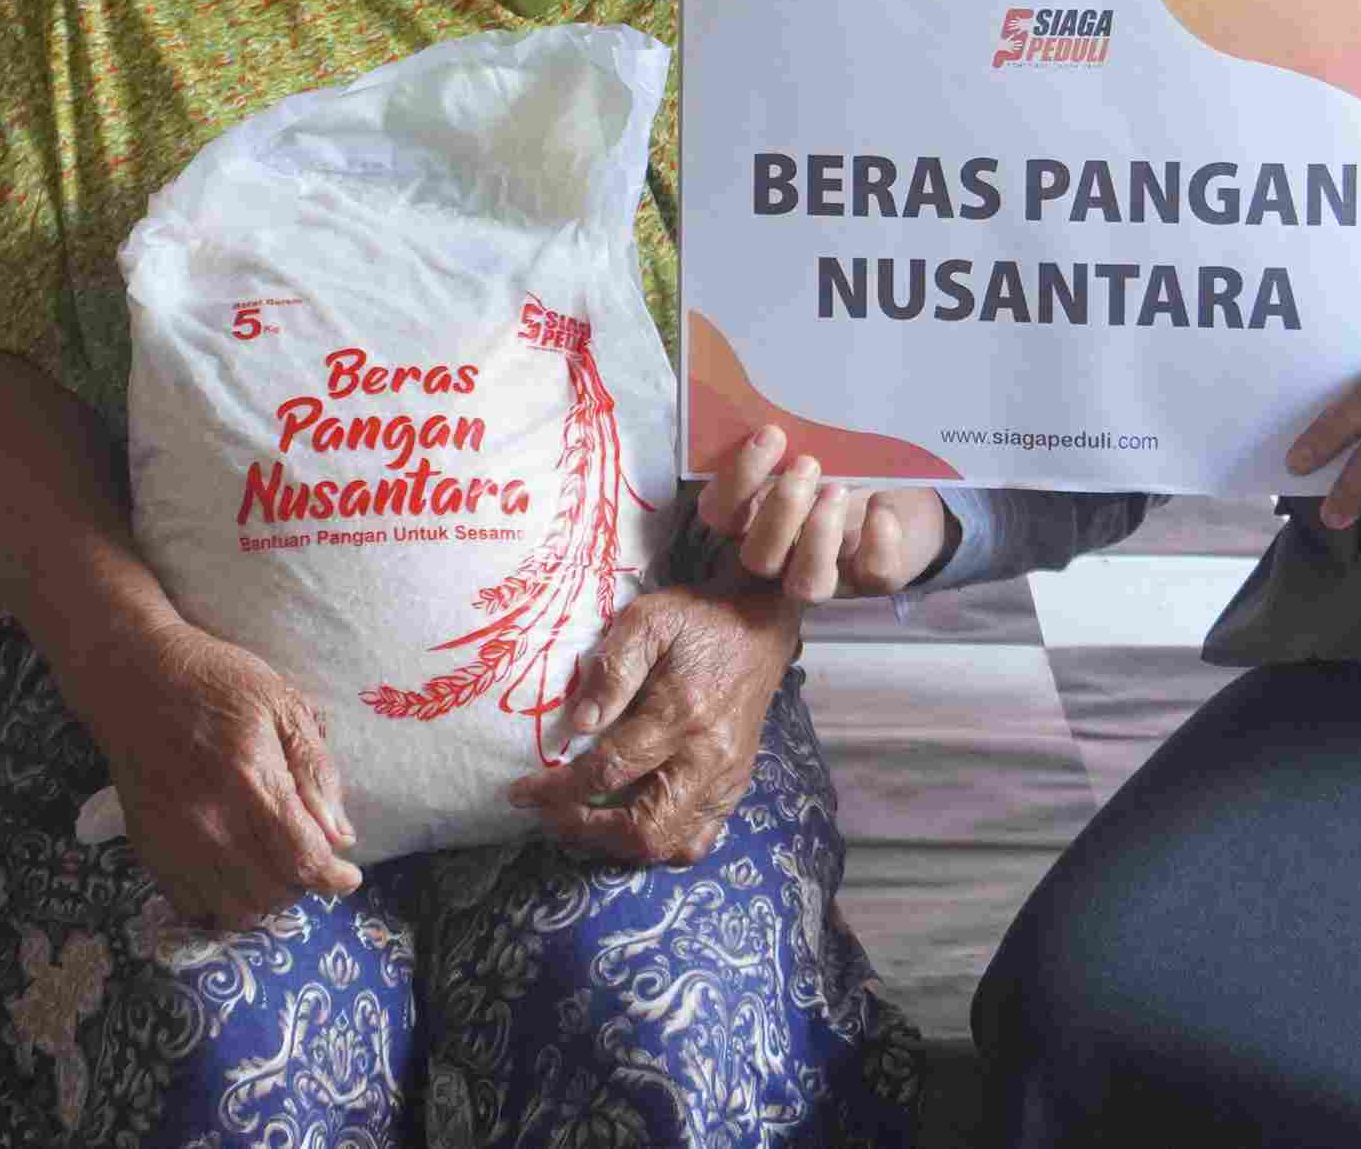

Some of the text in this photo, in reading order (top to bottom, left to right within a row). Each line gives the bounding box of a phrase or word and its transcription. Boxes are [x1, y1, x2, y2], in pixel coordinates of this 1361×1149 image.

[1034, 8, 1114, 37] SIAGA
[1026, 37, 1111, 62] PEDULI
[753, 153, 1358, 227] BERAS PANGAN
[818, 257, 1302, 331] NUSANTARA
[232, 308, 262, 340] 5
[325, 347, 479, 399] Beras
[276, 396, 486, 468] Pangan
[940, 428, 1159, 452] www.siagapeduli.com
[238, 457, 530, 526] Nusantara
[317, 529, 388, 548] Pangan
[393, 525, 448, 543] Untuk
